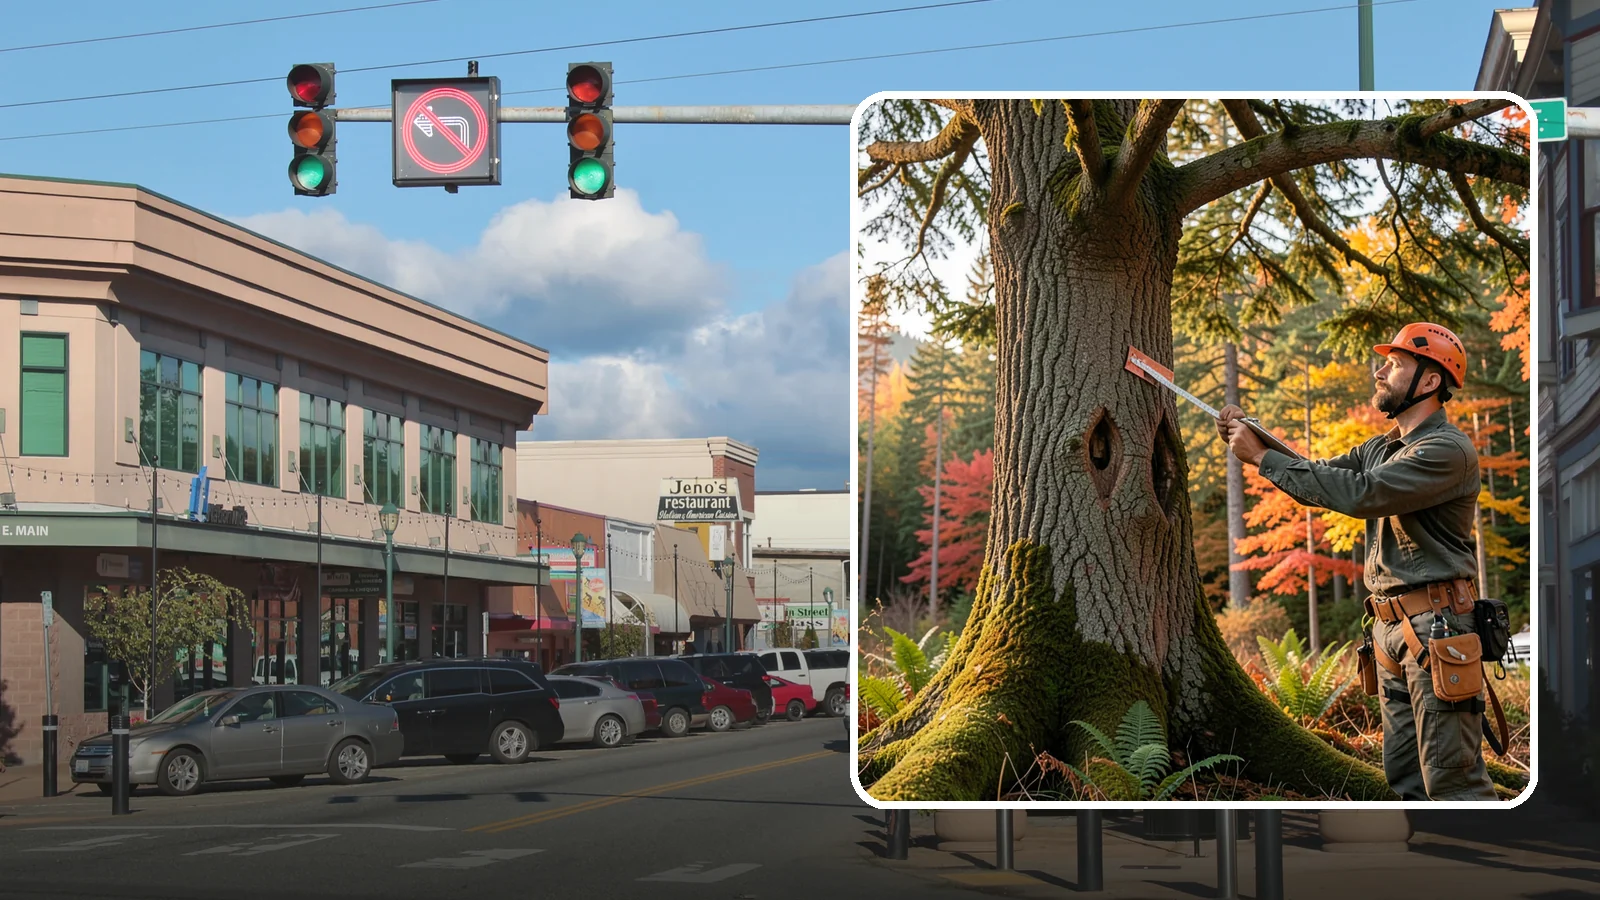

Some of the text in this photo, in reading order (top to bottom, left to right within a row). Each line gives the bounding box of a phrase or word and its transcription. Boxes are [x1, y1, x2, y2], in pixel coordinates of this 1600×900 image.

[669, 480, 727, 495] Jeno's
[665, 496, 731, 509] restaurant
[658, 509, 681, 519] Italian
[685, 509, 714, 519] American
[714, 509, 737, 519] Cuisine
[2, 525, 49, 536] E. MAIN
[797, 607, 828, 617] Street
[791, 619, 823, 627] lass
